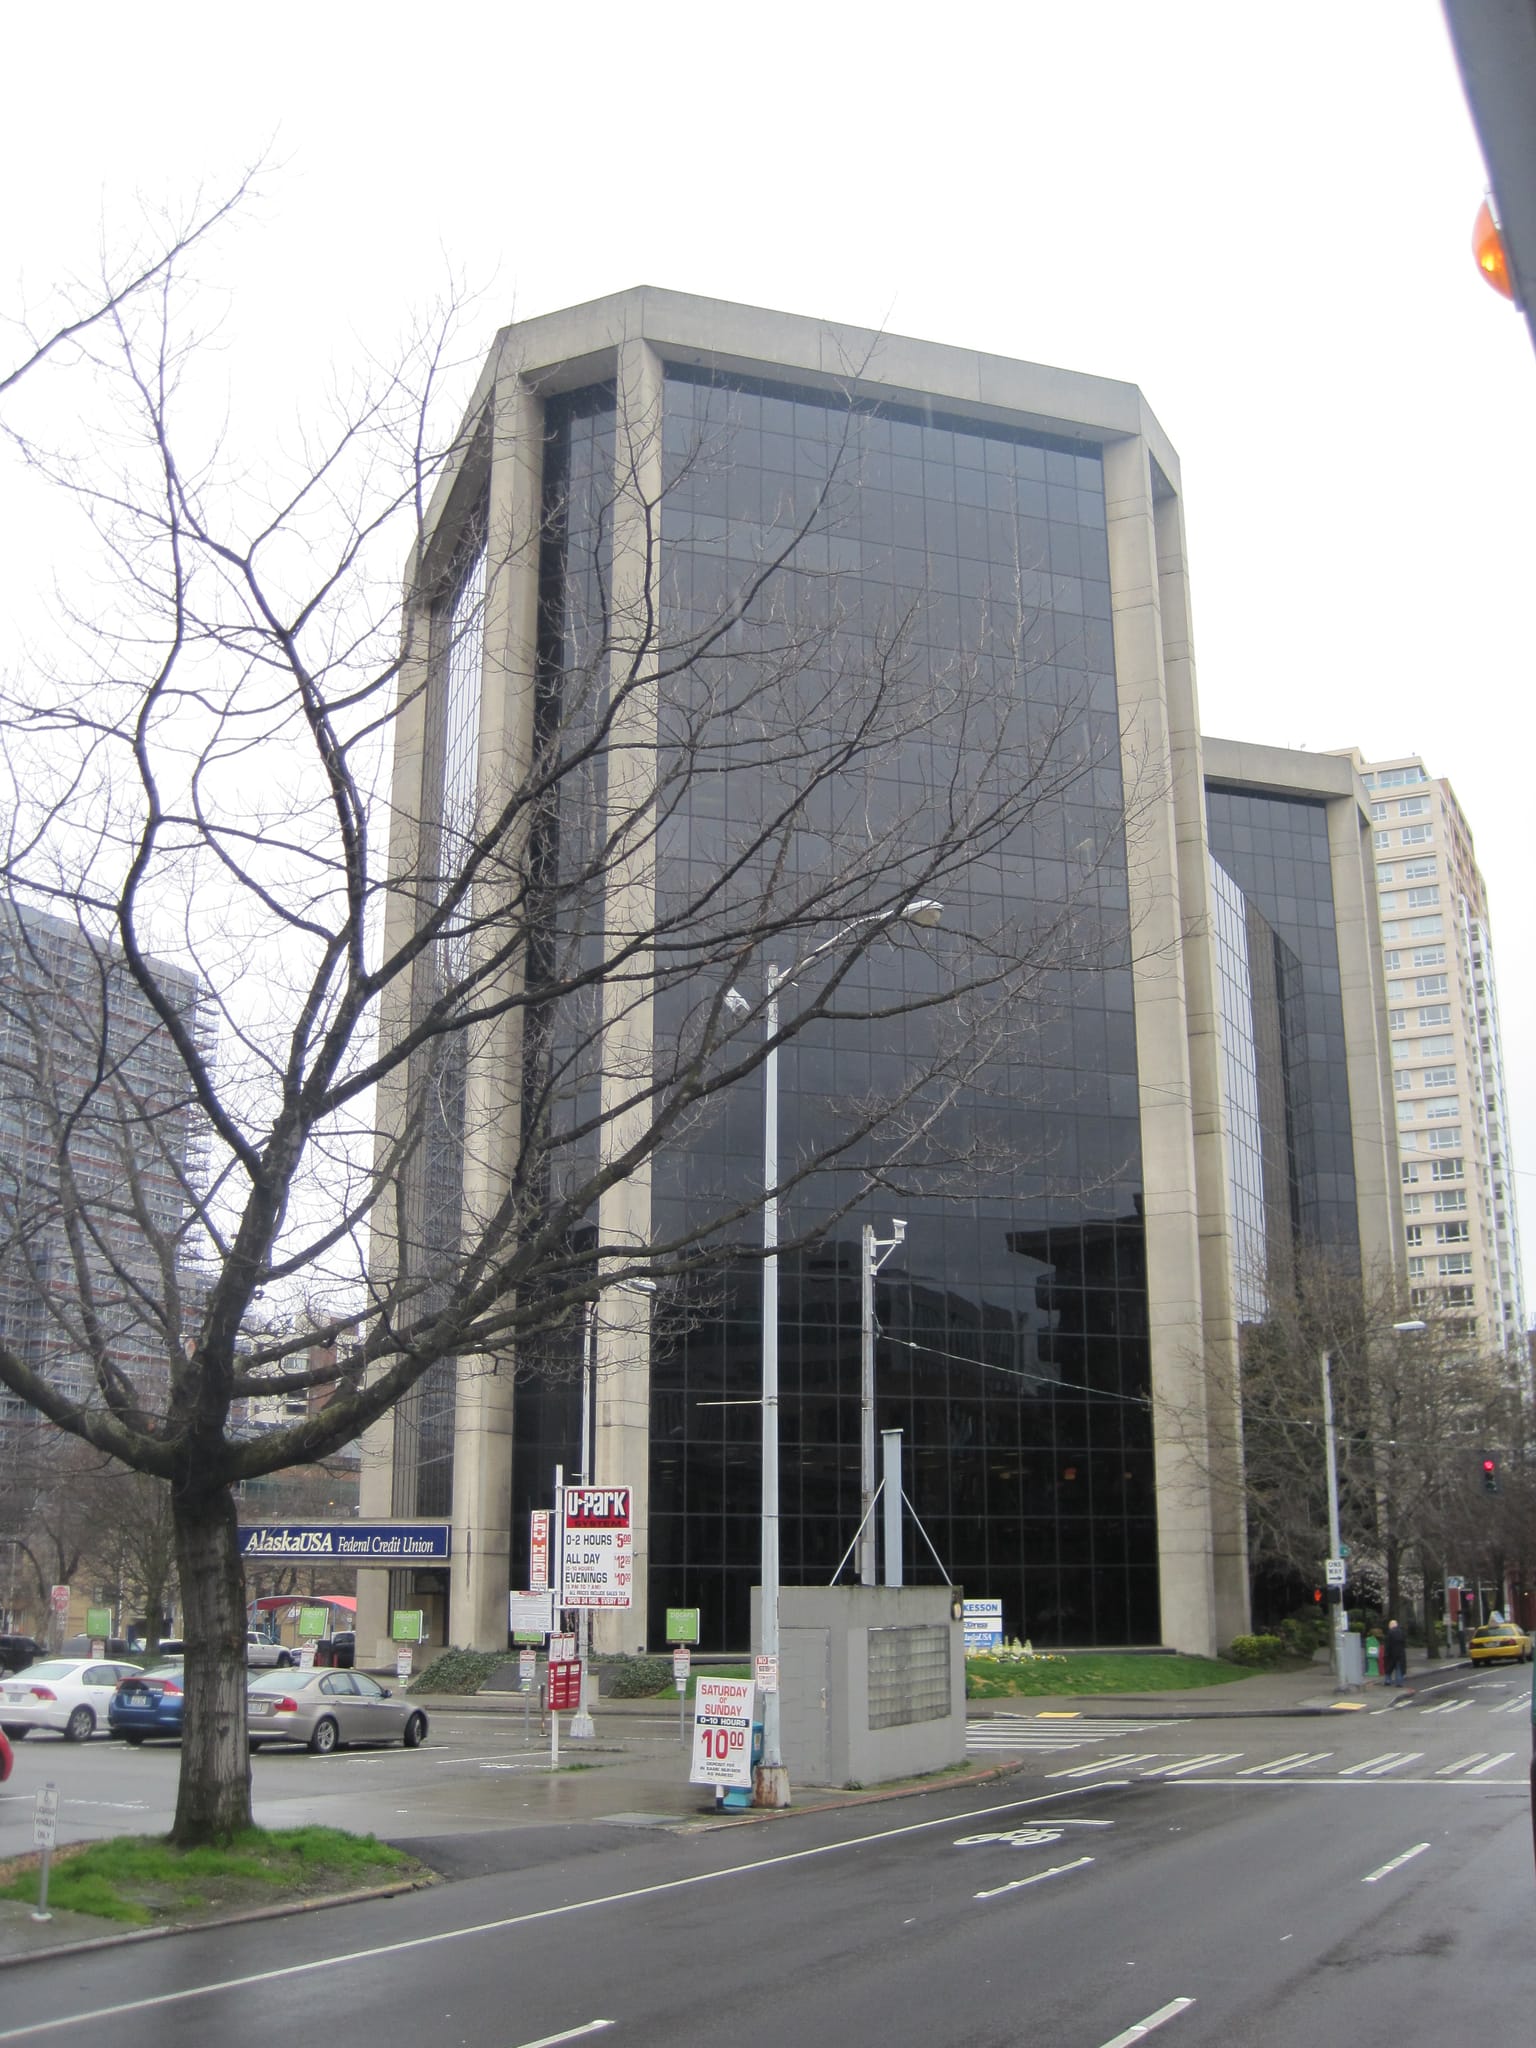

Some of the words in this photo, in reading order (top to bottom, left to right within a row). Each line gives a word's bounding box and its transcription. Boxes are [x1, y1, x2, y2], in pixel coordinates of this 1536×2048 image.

[533, 1514, 546, 1541] PAY
[575, 1520, 622, 1528] SYSTEM
[245, 1530, 333, 1552] AlaskaUSA
[338, 1536, 371, 1552] Federal
[372, 1536, 401, 1552] Credit
[403, 1536, 434, 1552] Union
[566, 1534, 581, 1545] 0-2
[583, 1534, 612, 1546] HOURS
[532, 1545, 546, 1581] HERE
[566, 1553, 581, 1564] ALL
[583, 1553, 601, 1564] DAY
[565, 1572, 608, 1583] EVENINGS
[567, 1597, 581, 1605] OPEN
[602, 1597, 616, 1605] EVERY
[618, 1597, 628, 1605] DAY
[701, 1684, 748, 1698] SATURDAY
[705, 1704, 742, 1717] SUNDAY
[720, 1718, 746, 1726] HOURS
